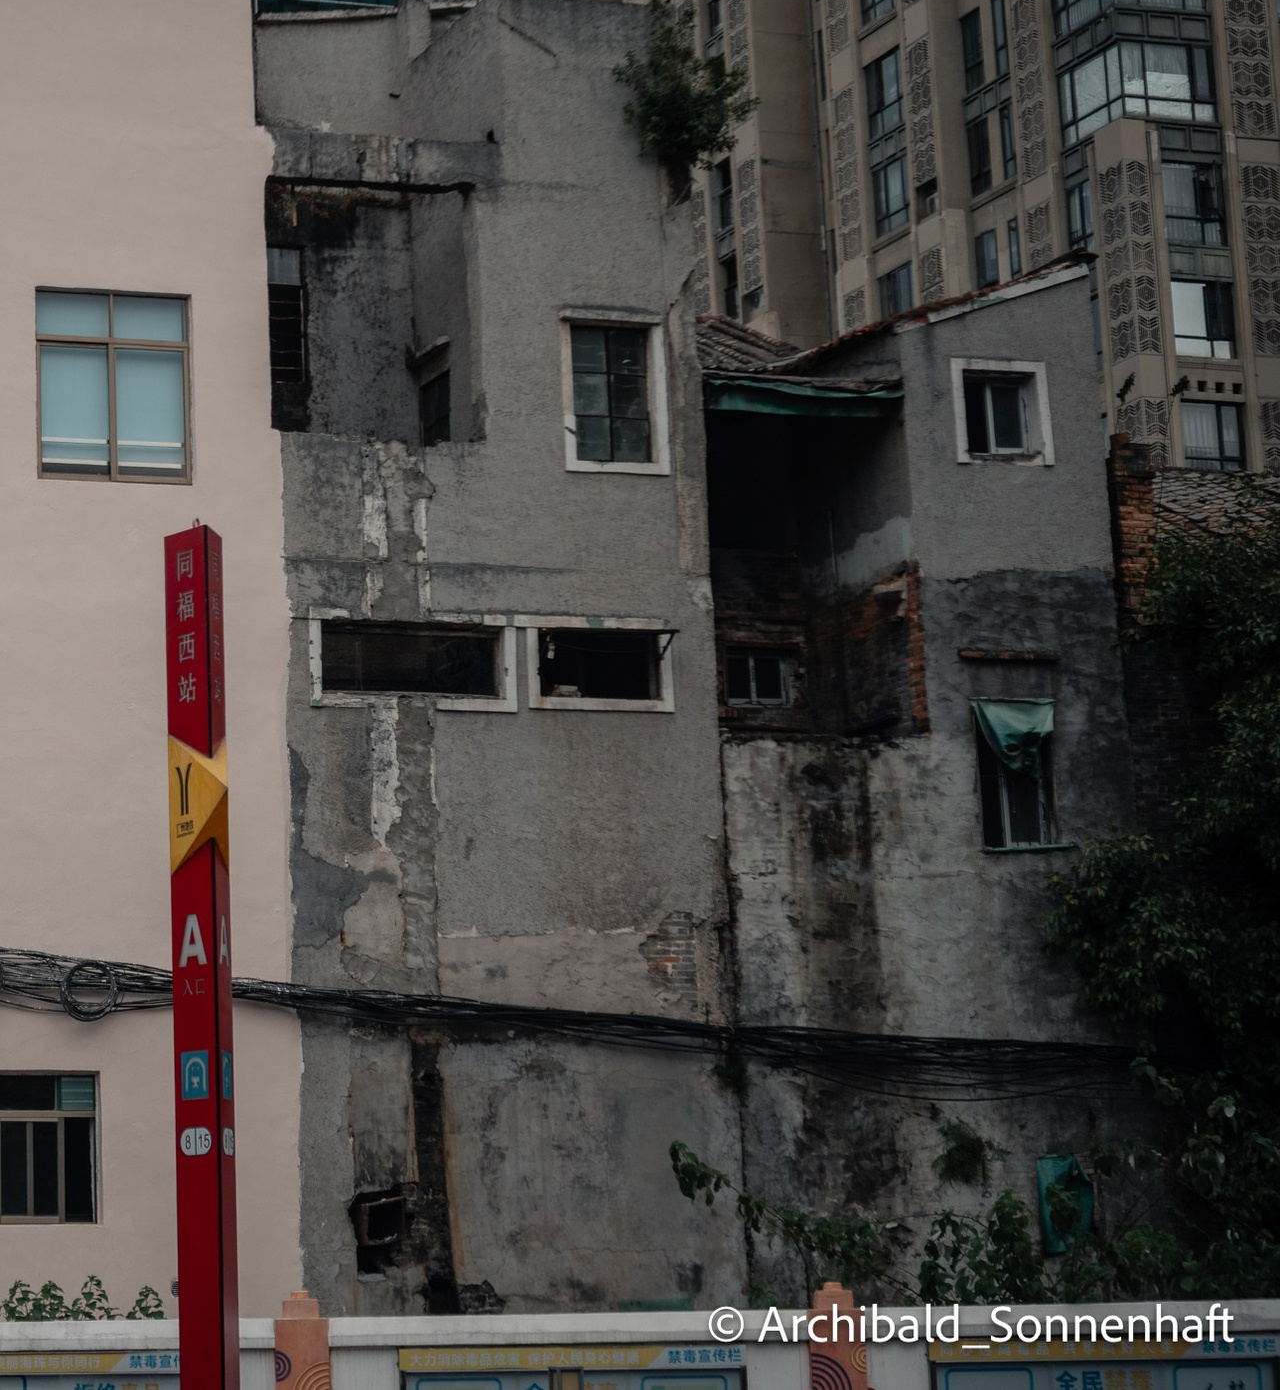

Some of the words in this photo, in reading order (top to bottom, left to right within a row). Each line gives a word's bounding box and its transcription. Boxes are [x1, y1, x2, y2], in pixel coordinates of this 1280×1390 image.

[176, 548, 197, 704] 同福西站
[179, 913, 208, 968] A
[182, 978, 206, 998] 入口
[185, 1135, 192, 1150] 8
[198, 1133, 210, 1149] 15
[1202, 1338, 1277, 1353] 禁毒宣传栏
[667, 1348, 742, 1364] 禁毒宣传栏
